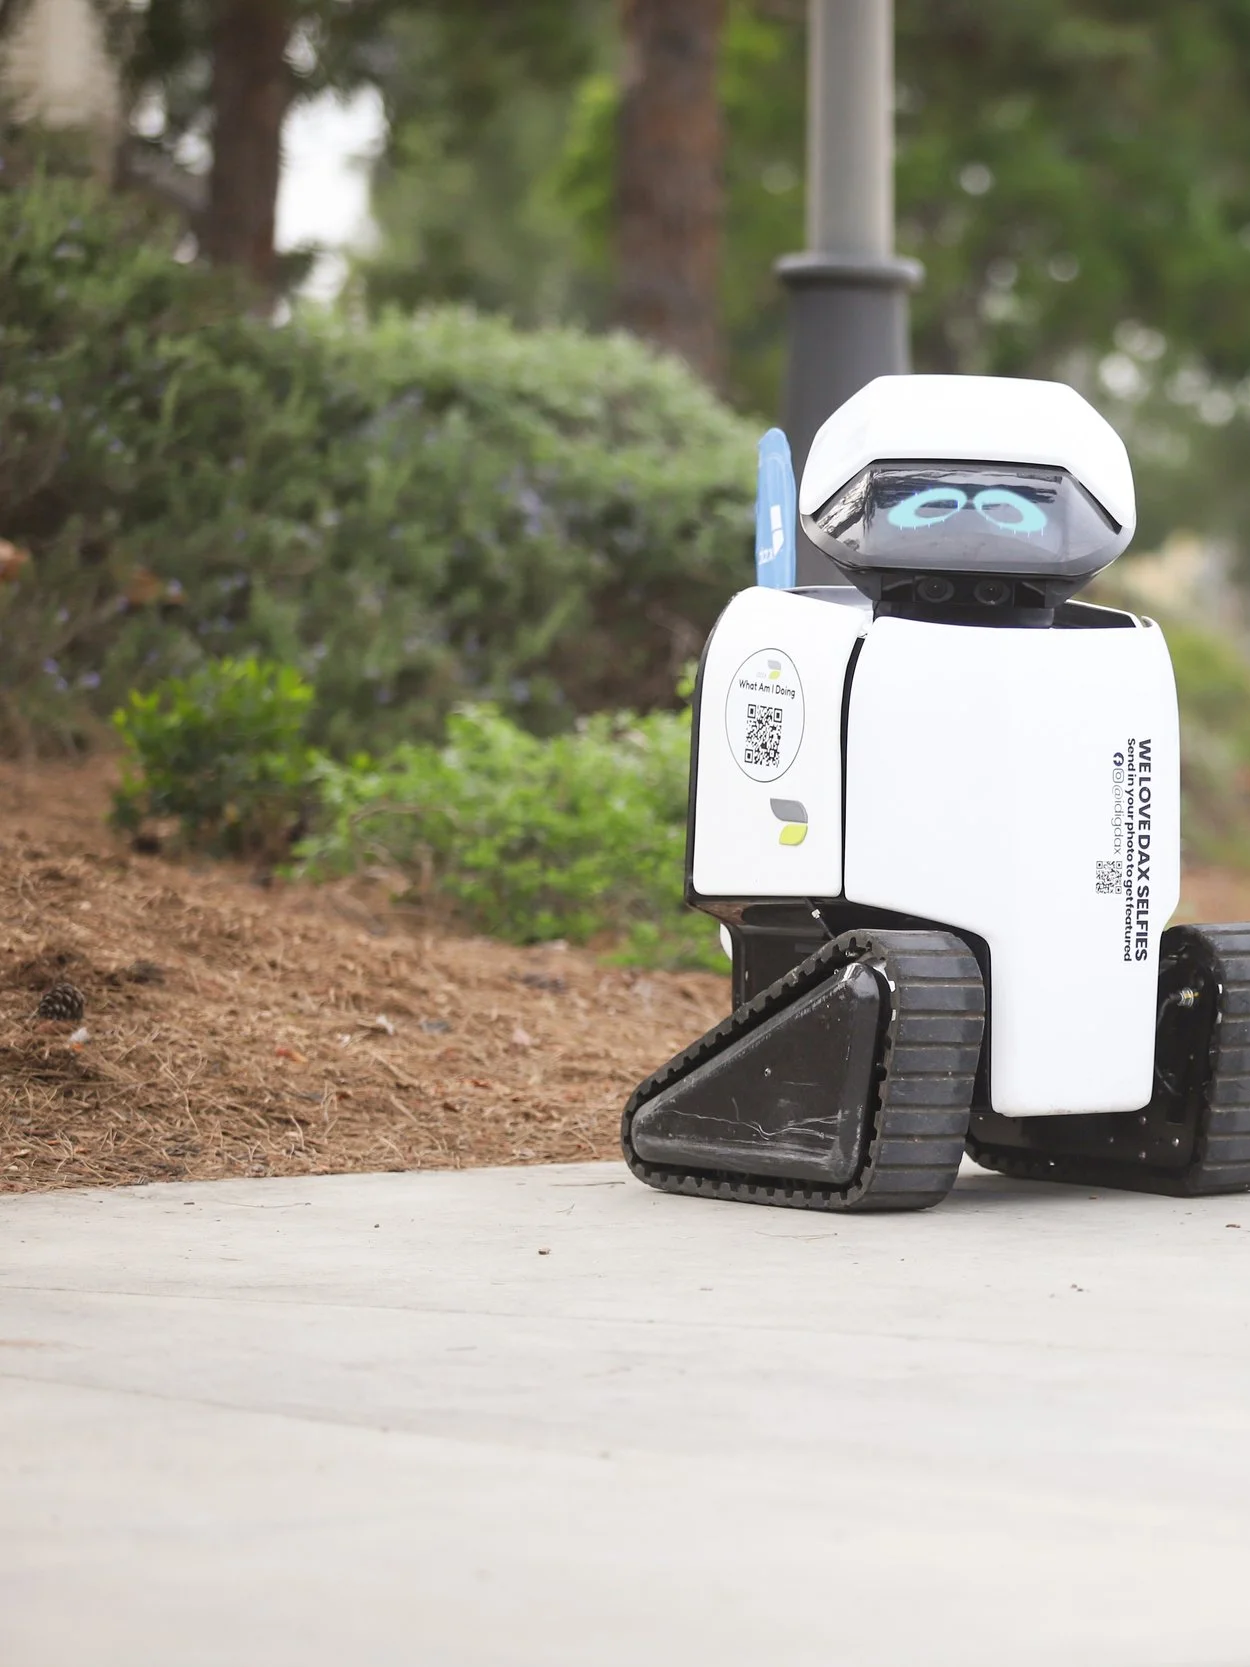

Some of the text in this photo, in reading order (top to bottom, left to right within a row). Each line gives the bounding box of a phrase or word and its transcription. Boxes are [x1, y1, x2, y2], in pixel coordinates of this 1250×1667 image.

[739, 679, 757, 691] What
[759, 683, 770, 693] Am
[776, 685, 795, 699] Doing
[1111, 785, 1124, 855] @idigdax
[1123, 738, 1136, 961] Send in your photo to get featured
[1135, 739, 1151, 961] WE LOVE DAX SELFIES
